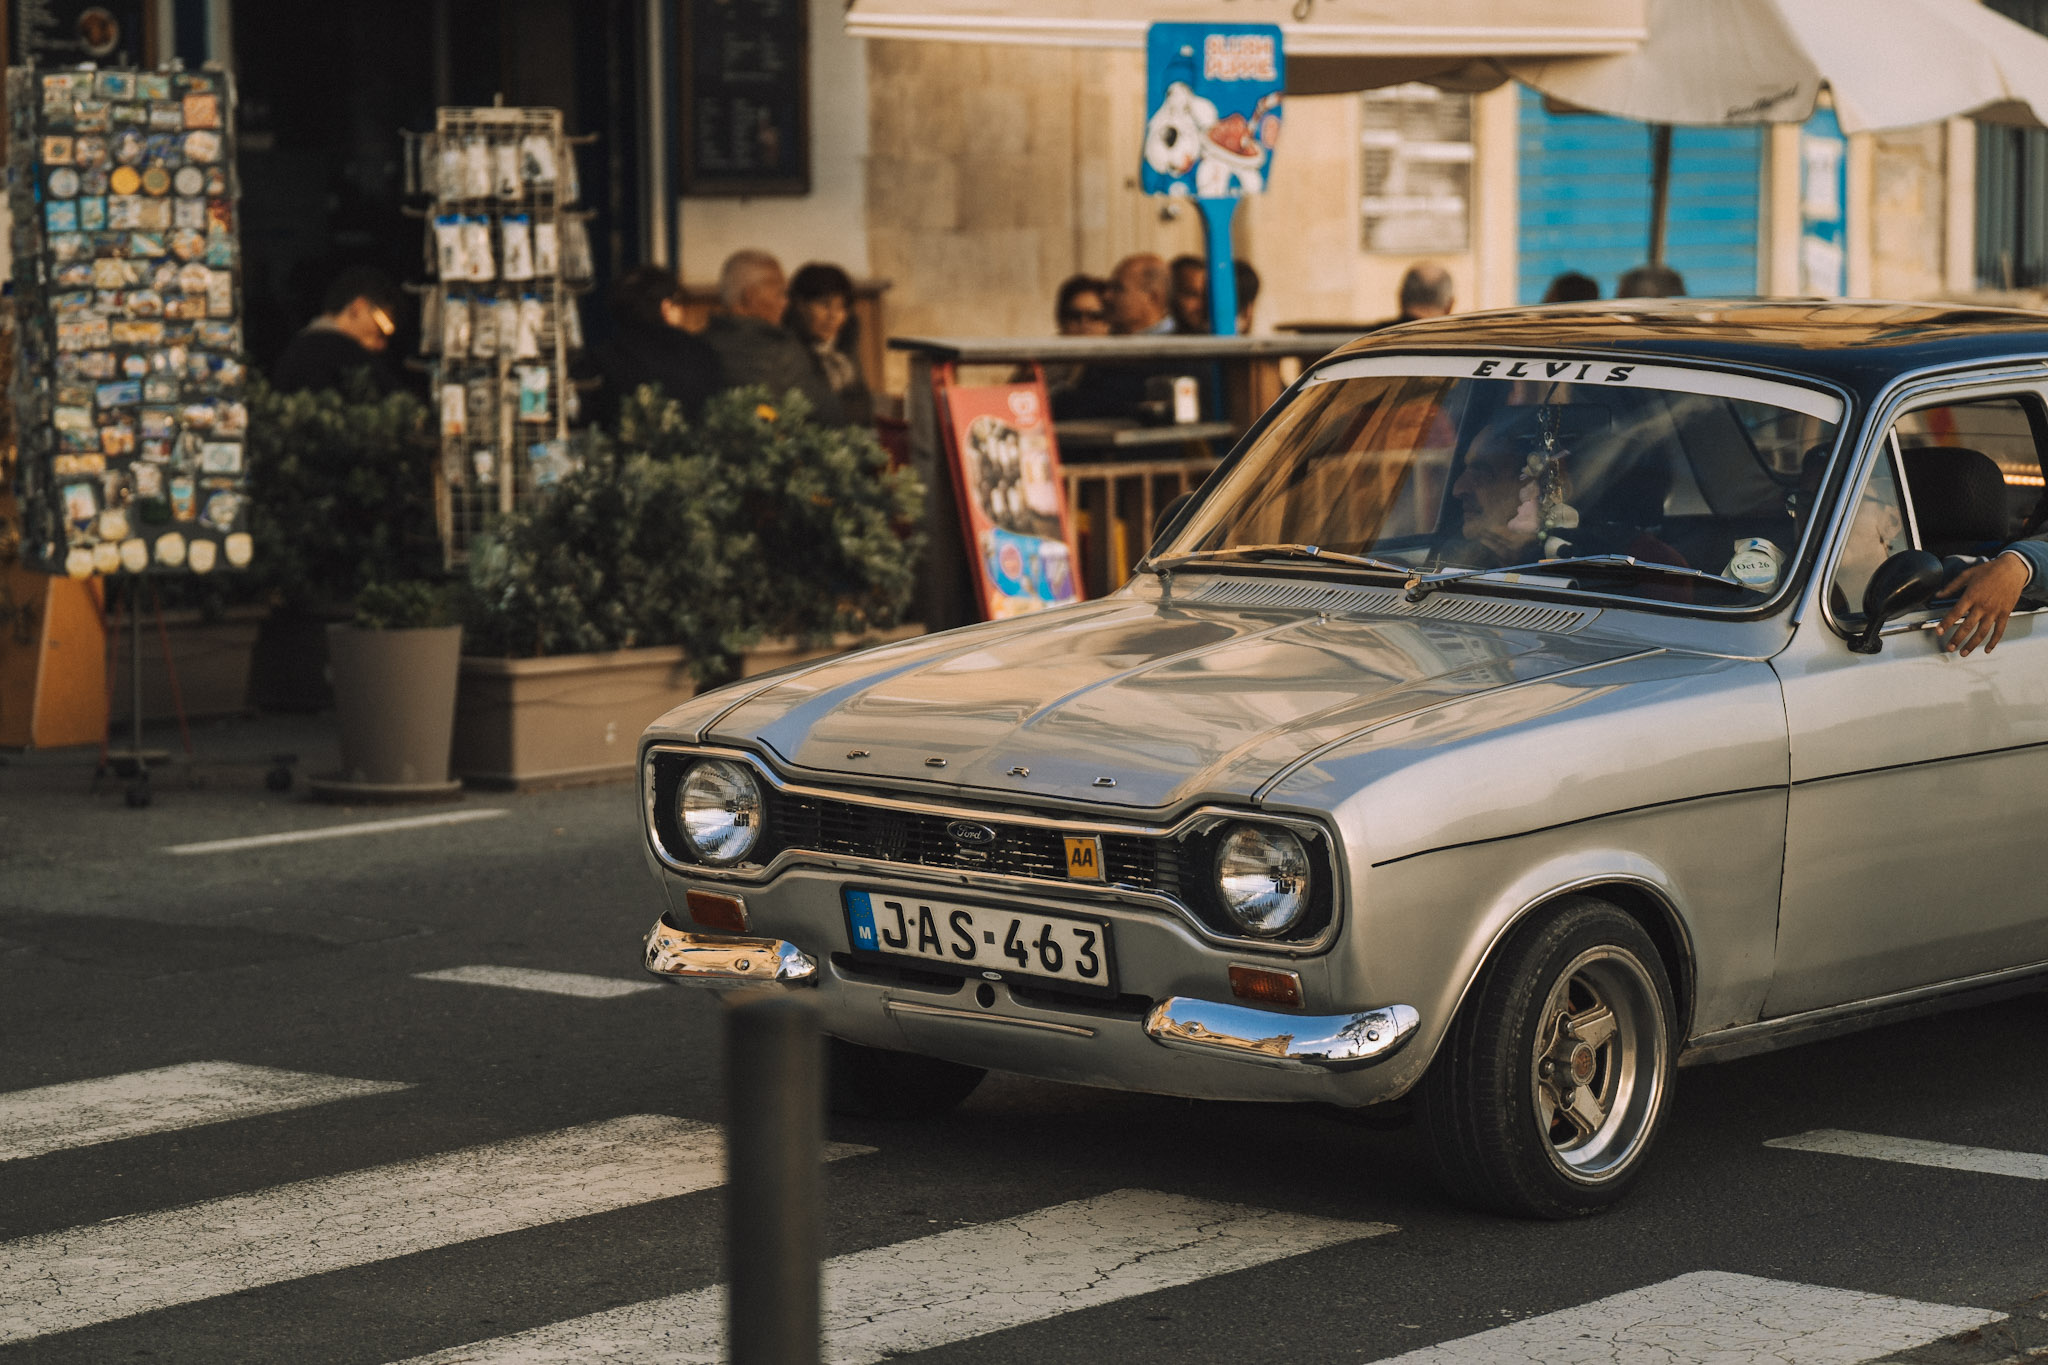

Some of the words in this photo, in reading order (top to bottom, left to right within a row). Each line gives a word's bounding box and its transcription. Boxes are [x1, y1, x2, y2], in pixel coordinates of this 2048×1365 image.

[1472, 360, 1636, 382] ELVIS
[1758, 561, 1770, 569] 26
[956, 824, 982, 840] Ford
[1071, 847, 1093, 867] AA
[858, 925, 872, 940] M
